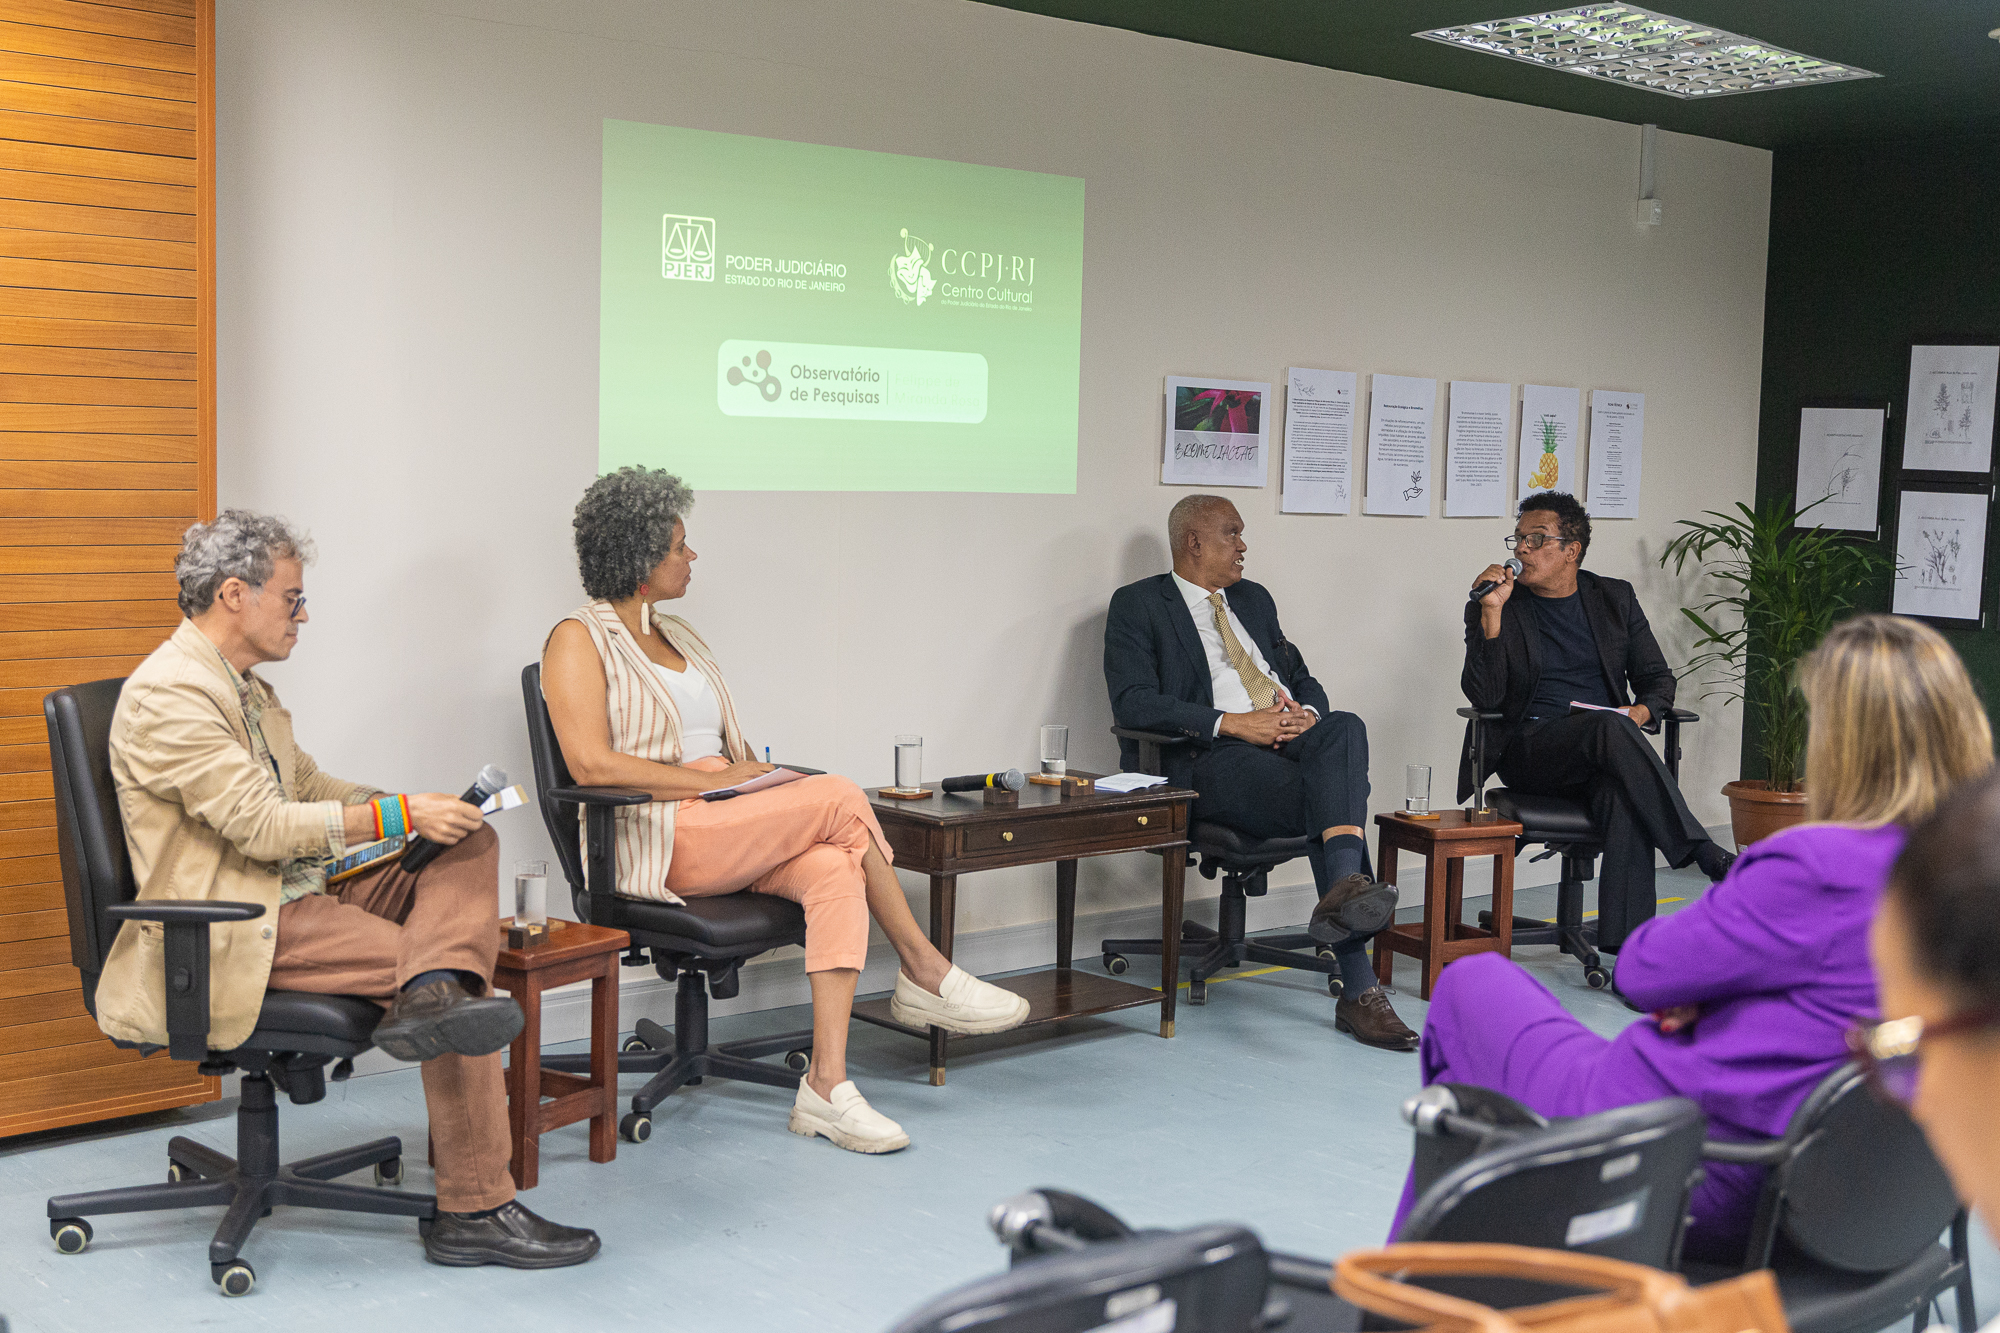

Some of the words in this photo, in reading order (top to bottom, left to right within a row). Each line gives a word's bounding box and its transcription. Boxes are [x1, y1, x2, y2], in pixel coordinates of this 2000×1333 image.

[664, 262, 713, 280] PJERJ
[725, 255, 772, 272] PODER
[774, 259, 847, 278] JUDICIÁRIO
[724, 274, 760, 287] ESTADO
[762, 277, 776, 288] DO
[777, 278, 793, 289] RIO
[794, 279, 807, 290] DE
[808, 281, 846, 293] JANEIRO
[941, 283, 983, 299] Centro
[986, 287, 1033, 304] Cultural
[790, 364, 880, 383] Observatório
[945, 374, 960, 388] de
[789, 386, 809, 401] de
[813, 387, 880, 406] Pesquisas
